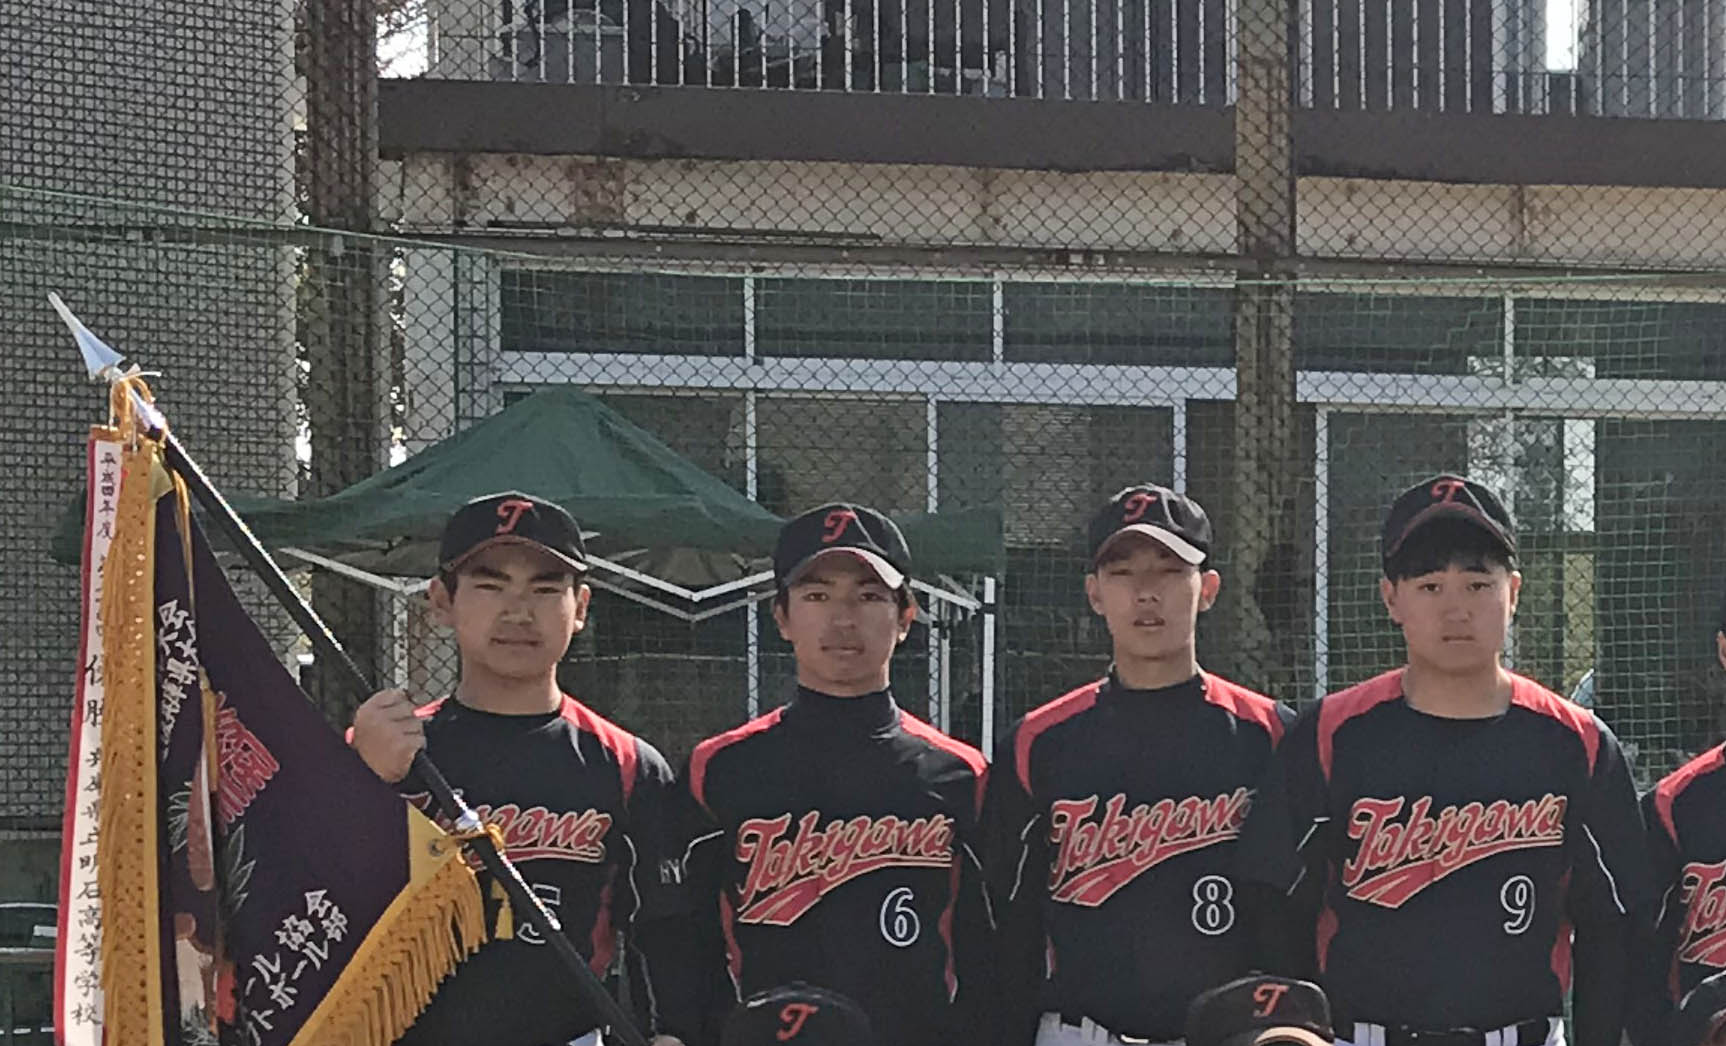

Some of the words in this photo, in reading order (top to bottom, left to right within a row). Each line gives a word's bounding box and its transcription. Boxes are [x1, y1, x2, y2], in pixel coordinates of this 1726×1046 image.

[1124, 492, 1157, 522] T
[1432, 479, 1465, 503] T
[496, 499, 534, 534] T
[823, 511, 856, 543] T
[1343, 793, 1568, 887] Takigawa
[880, 887, 921, 947] 6
[1191, 875, 1235, 935] 8
[1500, 874, 1535, 935] 9
[1252, 983, 1290, 1018] T
[776, 1002, 819, 1041] T
